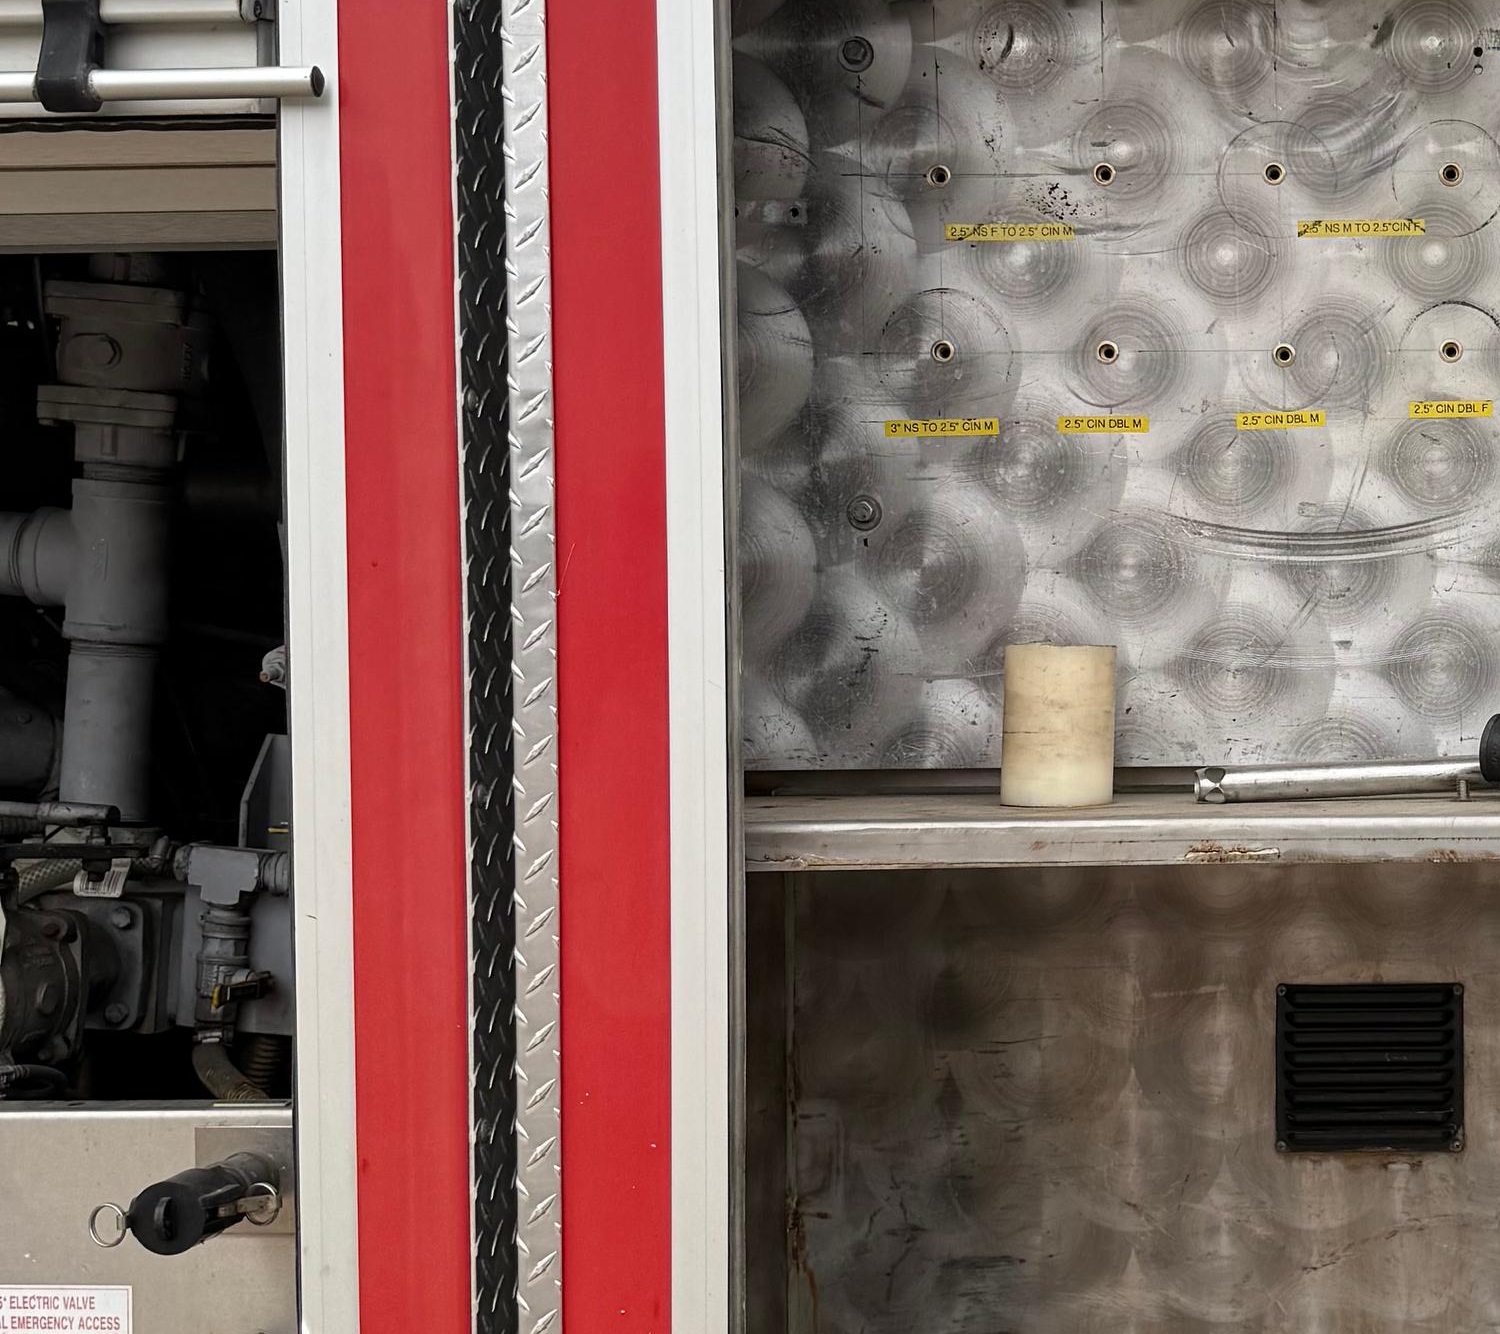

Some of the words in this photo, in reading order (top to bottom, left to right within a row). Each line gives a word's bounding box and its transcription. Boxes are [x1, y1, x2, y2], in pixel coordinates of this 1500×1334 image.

[973, 227, 988, 236] NS
[991, 227, 998, 236] F
[1002, 227, 1016, 236] TO
[1019, 227, 1037, 236] 2.5"
[1041, 227, 1060, 236] CIN
[1063, 227, 1072, 236] M
[1325, 223, 1340, 233] NS
[1343, 223, 1352, 233] M
[1355, 223, 1370, 232] TO
[1414, 404, 1433, 414] 2.5"
[1436, 404, 1454, 413] CIN
[1458, 403, 1479, 413] DBL
[1482, 403, 1488, 412] F
[1065, 419, 1083, 428] 2.5"
[1087, 419, 1106, 428] CIN
[1109, 419, 1129, 428] DBL
[1133, 419, 1141, 428] M
[1243, 416, 1261, 425] 2.5"
[1264, 415, 1283, 424] CIN
[1287, 414, 1307, 423] DBL
[1310, 413, 1319, 422] M
[891, 423, 900, 433] 3"
[904, 423, 919, 432] NS
[922, 423, 937, 432] TO
[962, 422, 981, 431] CIN
[984, 421, 993, 430] M
[9, 1295, 60, 1310] ELECTRIC
[63, 1296, 96, 1310] VALVE
[10, 1316, 74, 1330] EMERGENCY
[78, 1316, 121, 1330] ACCESS
